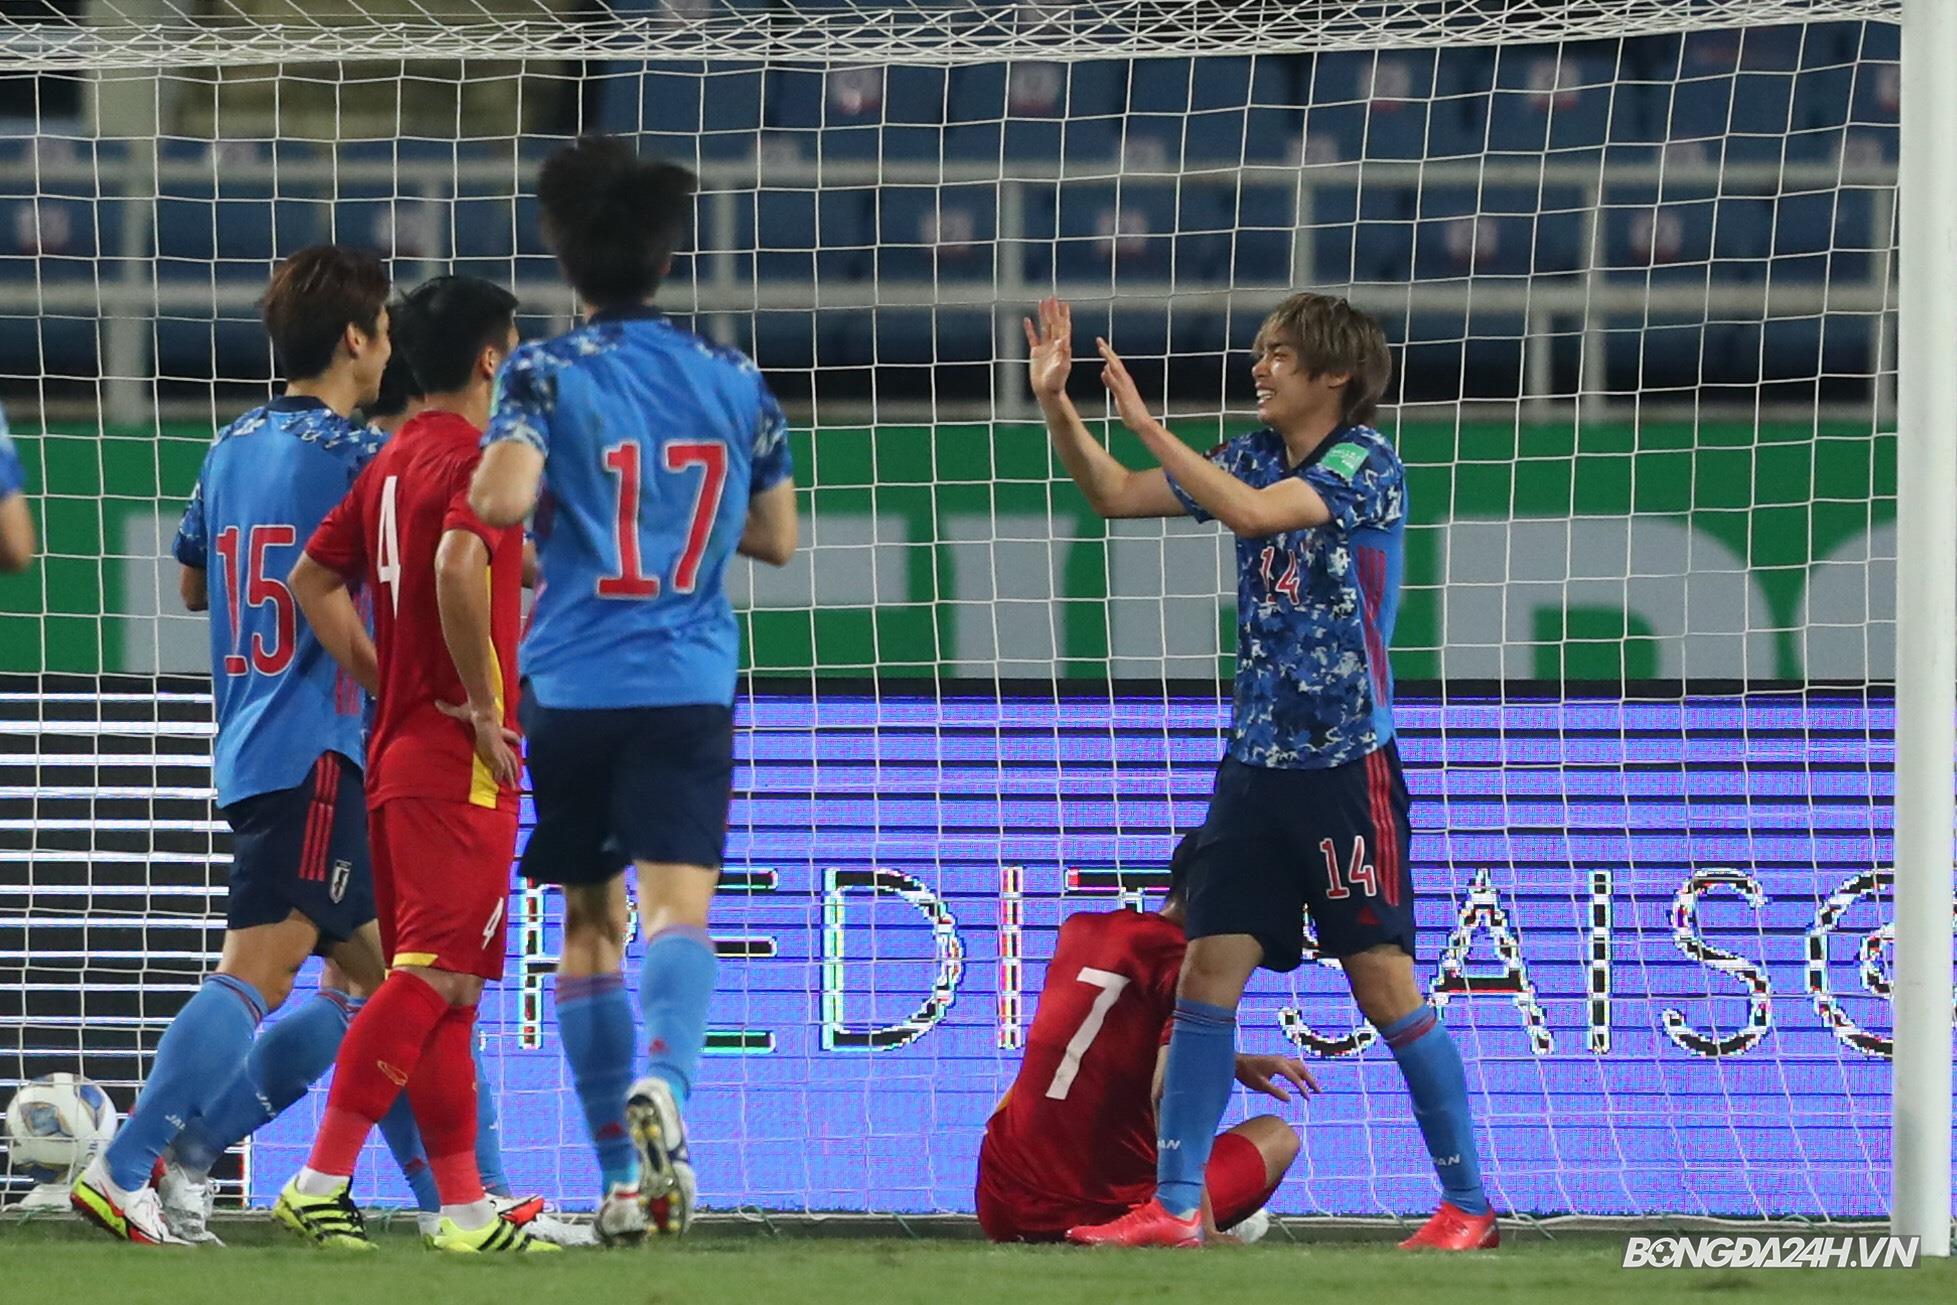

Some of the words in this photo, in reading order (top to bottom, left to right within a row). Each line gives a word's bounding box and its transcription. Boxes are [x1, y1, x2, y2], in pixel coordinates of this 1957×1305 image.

[377, 475, 401, 620] 4
[597, 440, 728, 599] 17
[1261, 546, 1301, 606] 14
[216, 524, 297, 679] 15
[482, 897, 504, 950] 4
[1319, 835, 1378, 900] 14
[1046, 966, 1131, 1100] 7
